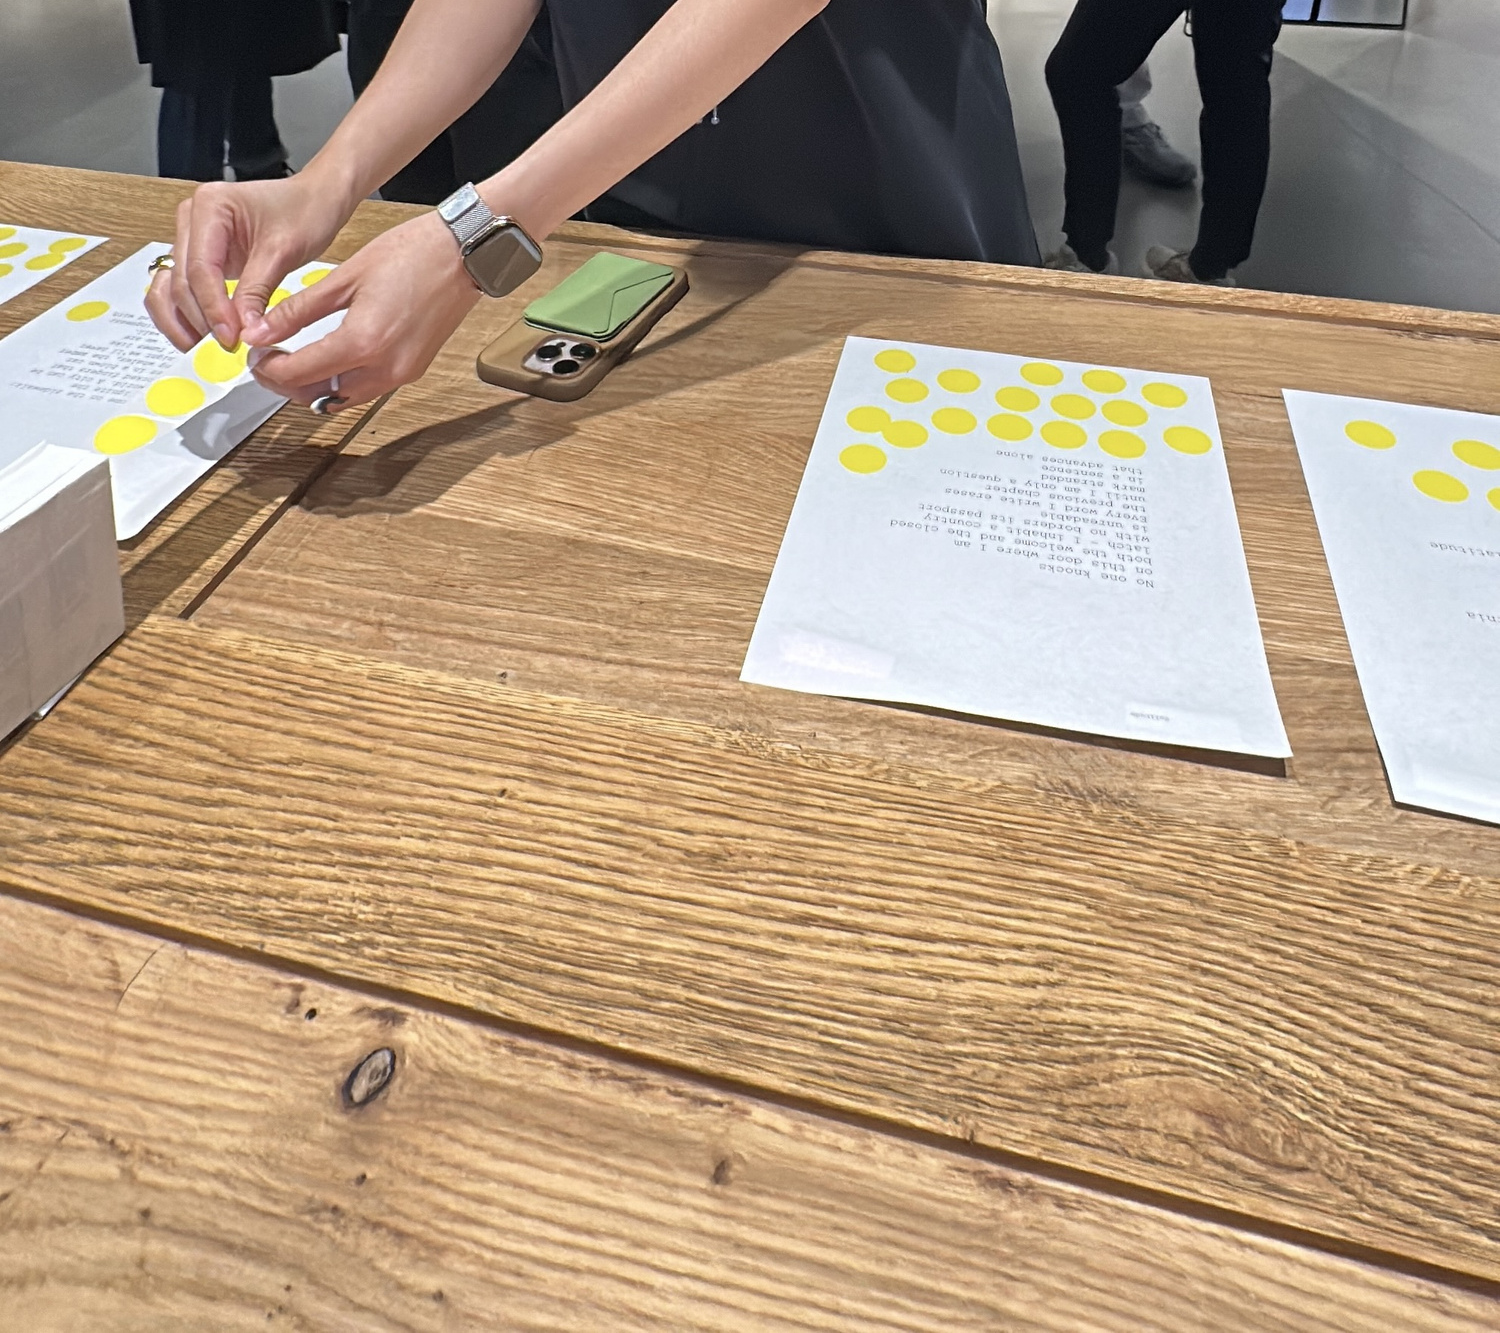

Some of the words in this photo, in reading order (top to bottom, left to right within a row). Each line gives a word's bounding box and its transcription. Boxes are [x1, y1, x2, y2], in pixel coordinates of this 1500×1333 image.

[996, 450, 1033, 460] alone
[1042, 456, 1104, 469] advances
[940, 469, 1001, 482] question
[1041, 465, 1103, 478] sentence
[1113, 466, 1142, 475] that
[1025, 480, 1056, 490] only
[1041, 474, 1104, 487] stranded
[1128, 476, 1143, 485] in
[945, 488, 992, 499] erases
[985, 485, 1040, 497] chapter
[1113, 483, 1145, 493] mark
[1000, 496, 1040, 507] write
[1049, 493, 1113, 507] previous
[1106, 492, 1146, 502] until
[919, 503, 982, 518] passport
[1065, 505, 1098, 515] word
[1122, 504, 1146, 513] the
[924, 513, 981, 528] country
[991, 514, 1013, 524] its
[1041, 512, 1123, 529] unreadable
[1106, 510, 1147, 523] Every
[890, 519, 939, 532] closed
[1024, 519, 1081, 534] borders
[1132, 524, 1147, 533] is
[948, 528, 971, 538] the
[980, 533, 1005, 542] and
[1007, 527, 1063, 542] inhabit
[1116, 532, 1150, 542] with
[1014, 538, 1073, 552] welcome
[1107, 541, 1150, 554] latch
[996, 546, 1039, 558] where
[1083, 548, 1107, 558] the
[1047, 554, 1083, 566] door
[1117, 553, 1152, 566] both
[1039, 563, 1090, 579] knocks
[1092, 560, 1125, 572] this
[1135, 567, 1153, 575] on
[1101, 573, 1127, 582] one
[1136, 579, 1154, 588] No
